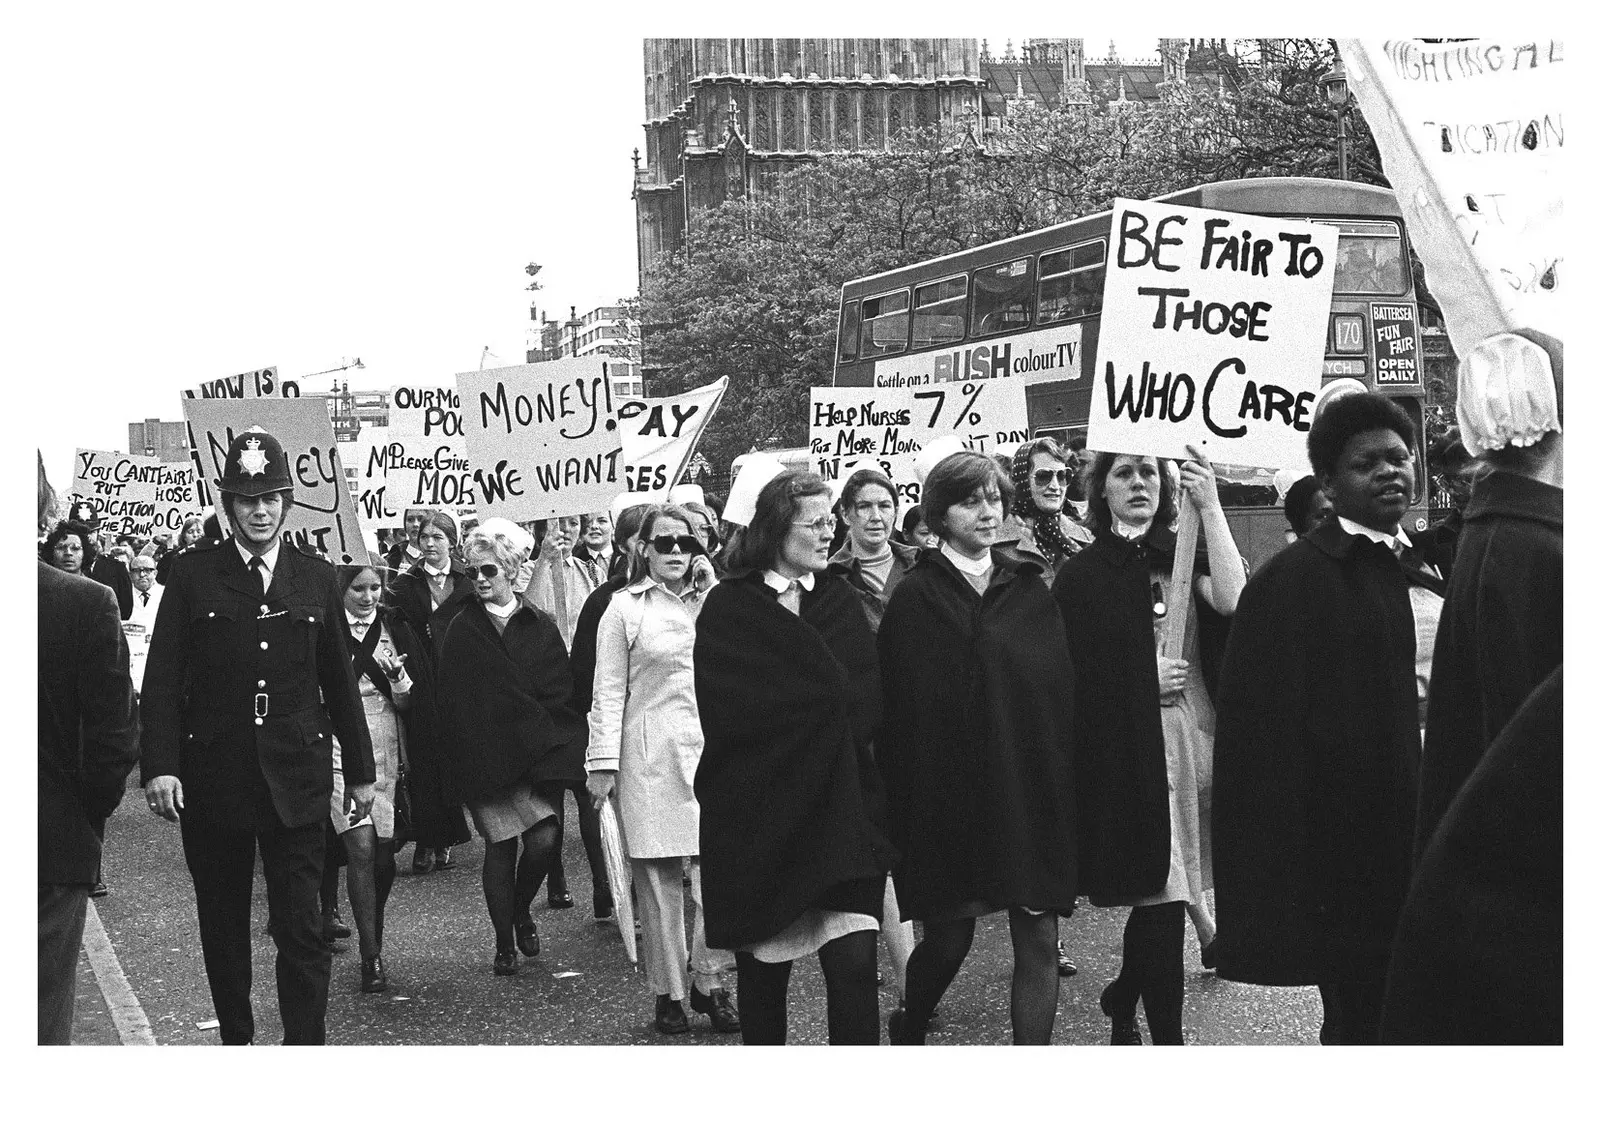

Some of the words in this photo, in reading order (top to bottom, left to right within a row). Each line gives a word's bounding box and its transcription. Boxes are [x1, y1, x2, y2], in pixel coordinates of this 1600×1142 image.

[1117, 210, 1188, 271] BE
[1279, 232, 1324, 278] TO
[1138, 287, 1272, 341] THOSE
[1373, 306, 1412, 321] BATTERSEA
[1338, 322, 1360, 345] 170
[1376, 324, 1400, 342] FUN
[1013, 349, 1057, 374] colour
[1056, 341, 1078, 368] TV
[1389, 337, 1414, 355] FAIR
[1325, 362, 1352, 374] YCH
[1378, 359, 1415, 369] OPEN
[1378, 371, 1415, 381] DAILY
[202, 373, 244, 398] NOW
[255, 369, 274, 397] IS
[395, 387, 434, 409] OUR
[436, 388, 460, 409] MO
[480, 362, 617, 439] MONEY!
[1105, 361, 1195, 422] WHO
[1202, 358, 1316, 438] CARE
[618, 401, 698, 438] PAY
[833, 429, 877, 456] MORE
[94, 481, 126, 496] PUT
[413, 469, 476, 505] MOR
[473, 459, 523, 505] WE
[536, 447, 623, 493] WANT
[119, 516, 155, 536] BANK
